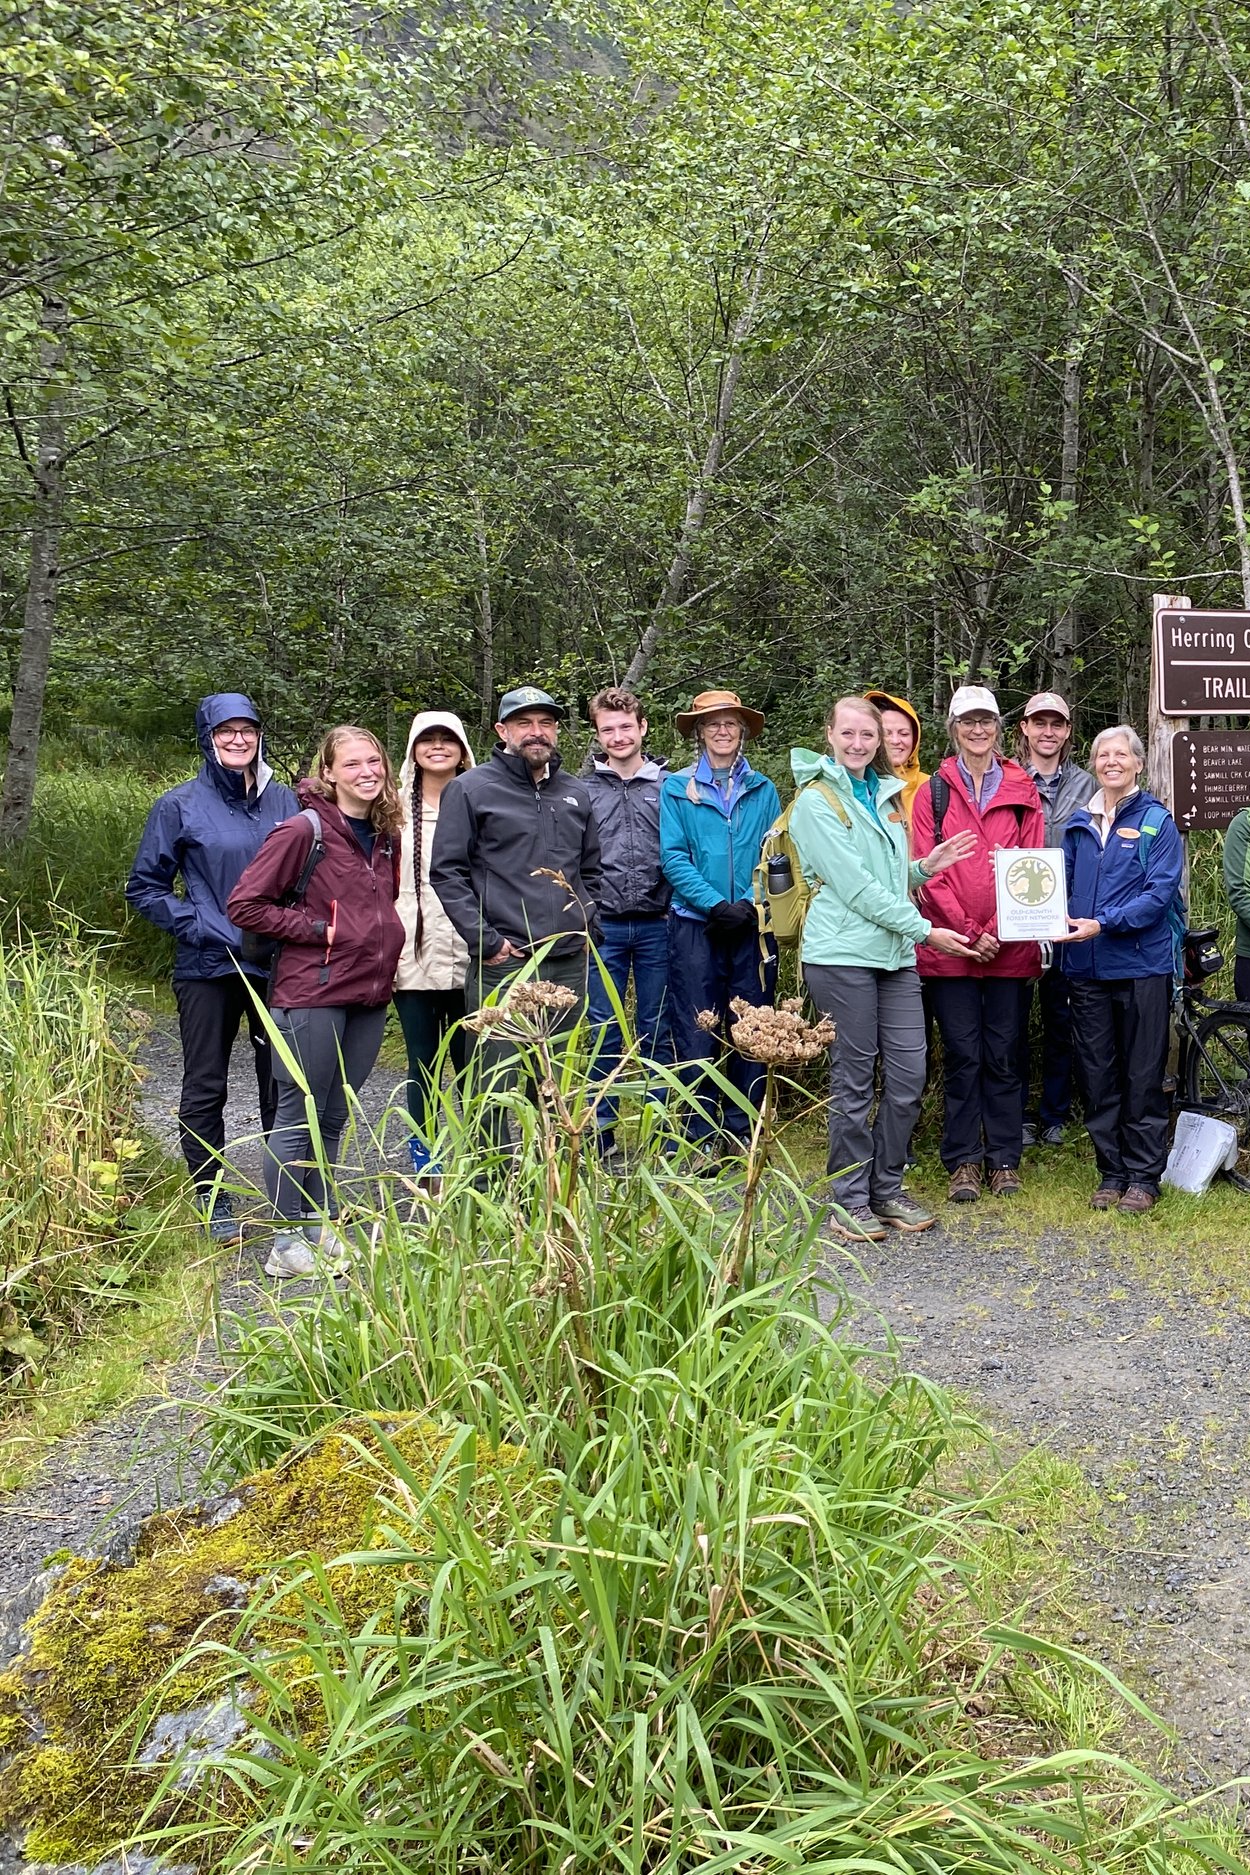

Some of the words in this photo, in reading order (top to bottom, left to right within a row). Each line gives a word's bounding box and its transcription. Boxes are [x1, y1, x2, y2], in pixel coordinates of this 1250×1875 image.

[1171, 627, 1235, 654] Herring
[1202, 745, 1219, 753] BEAR
[1203, 758, 1226, 767] BEAVER
[1227, 757, 1243, 766] LAKE
[1204, 771, 1229, 780] SAWMILL
[1204, 784, 1248, 793] THIMBLEBERRY
[1204, 795, 1229, 803] SAWMILL
[1230, 795, 1250, 803] CREEK
[1204, 811, 1220, 819] LOOP
[1221, 810, 1235, 818] HIKE
